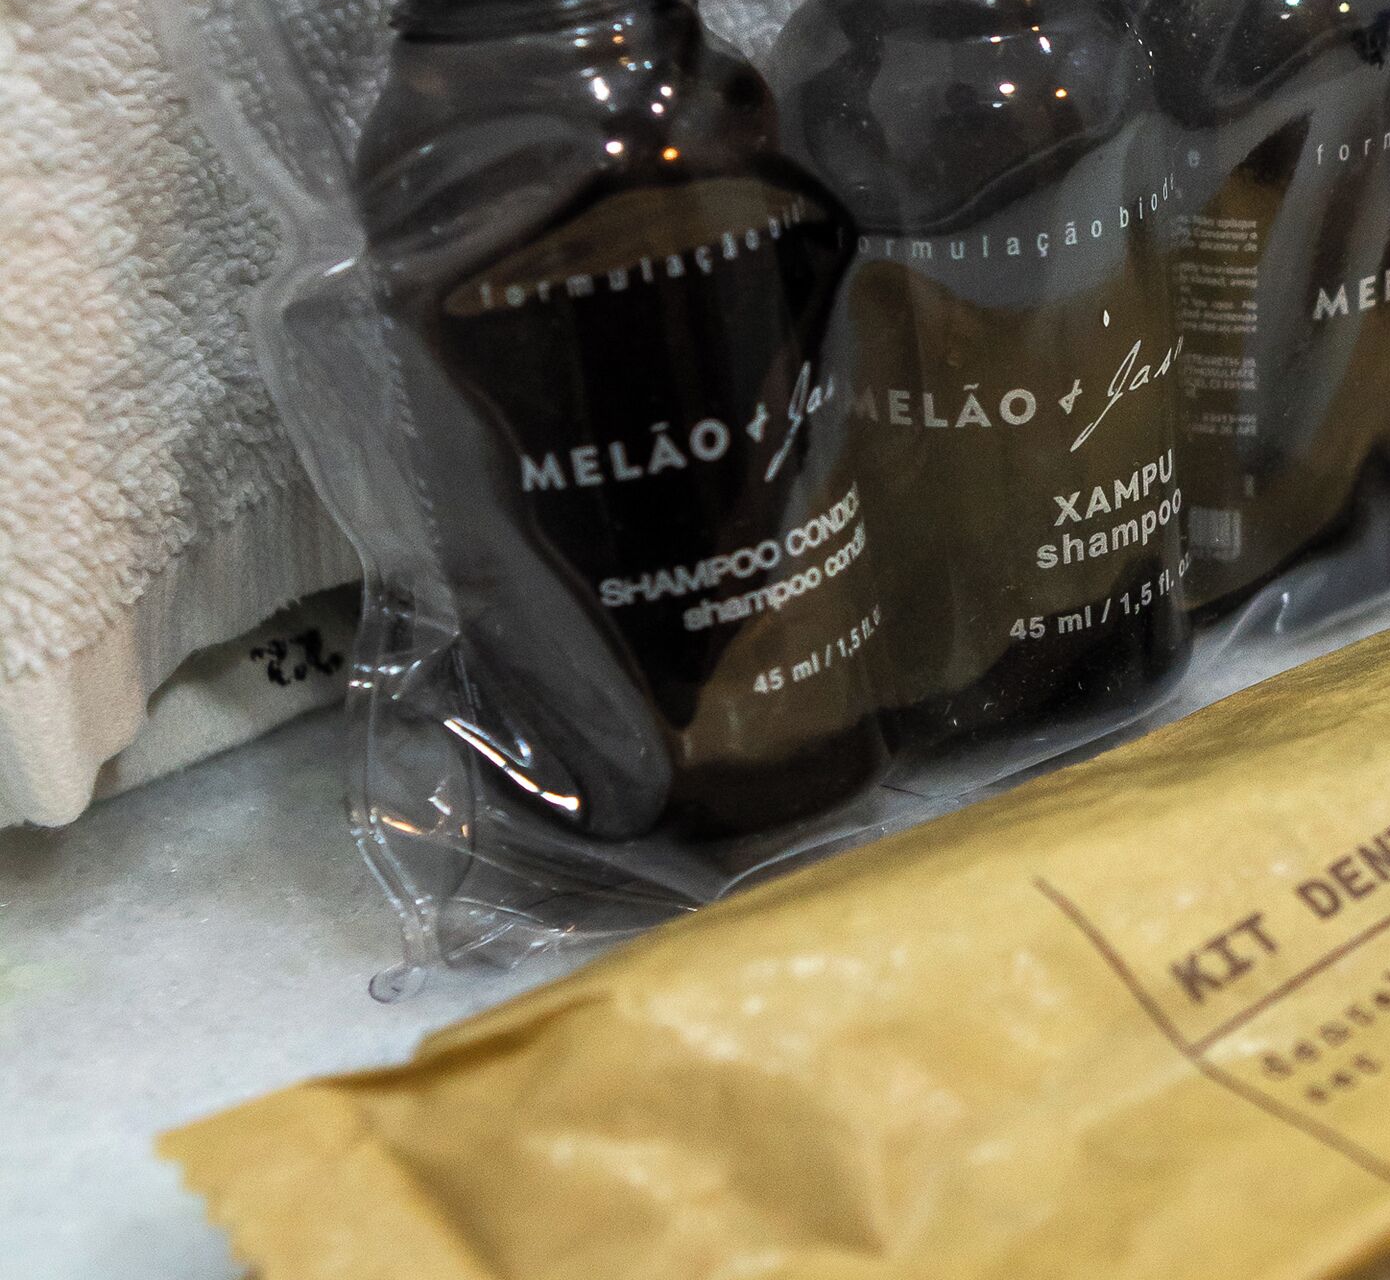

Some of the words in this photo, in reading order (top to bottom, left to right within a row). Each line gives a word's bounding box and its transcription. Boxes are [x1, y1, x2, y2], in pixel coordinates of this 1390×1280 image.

[520, 420, 731, 493] MELÃO
[1053, 448, 1173, 526] XAMPU
[1036, 488, 1182, 569] shampoo
[600, 540, 782, 607] SHAMPOO
[683, 566, 822, 631] shampoo
[1009, 616, 1046, 640] 45
[1057, 605, 1092, 634] ml
[1101, 598, 1111, 624] /
[1119, 581, 1153, 615] 1,5
[753, 667, 785, 694] 45
[792, 651, 820, 682] ml
[1170, 912, 1280, 1005] KIT
